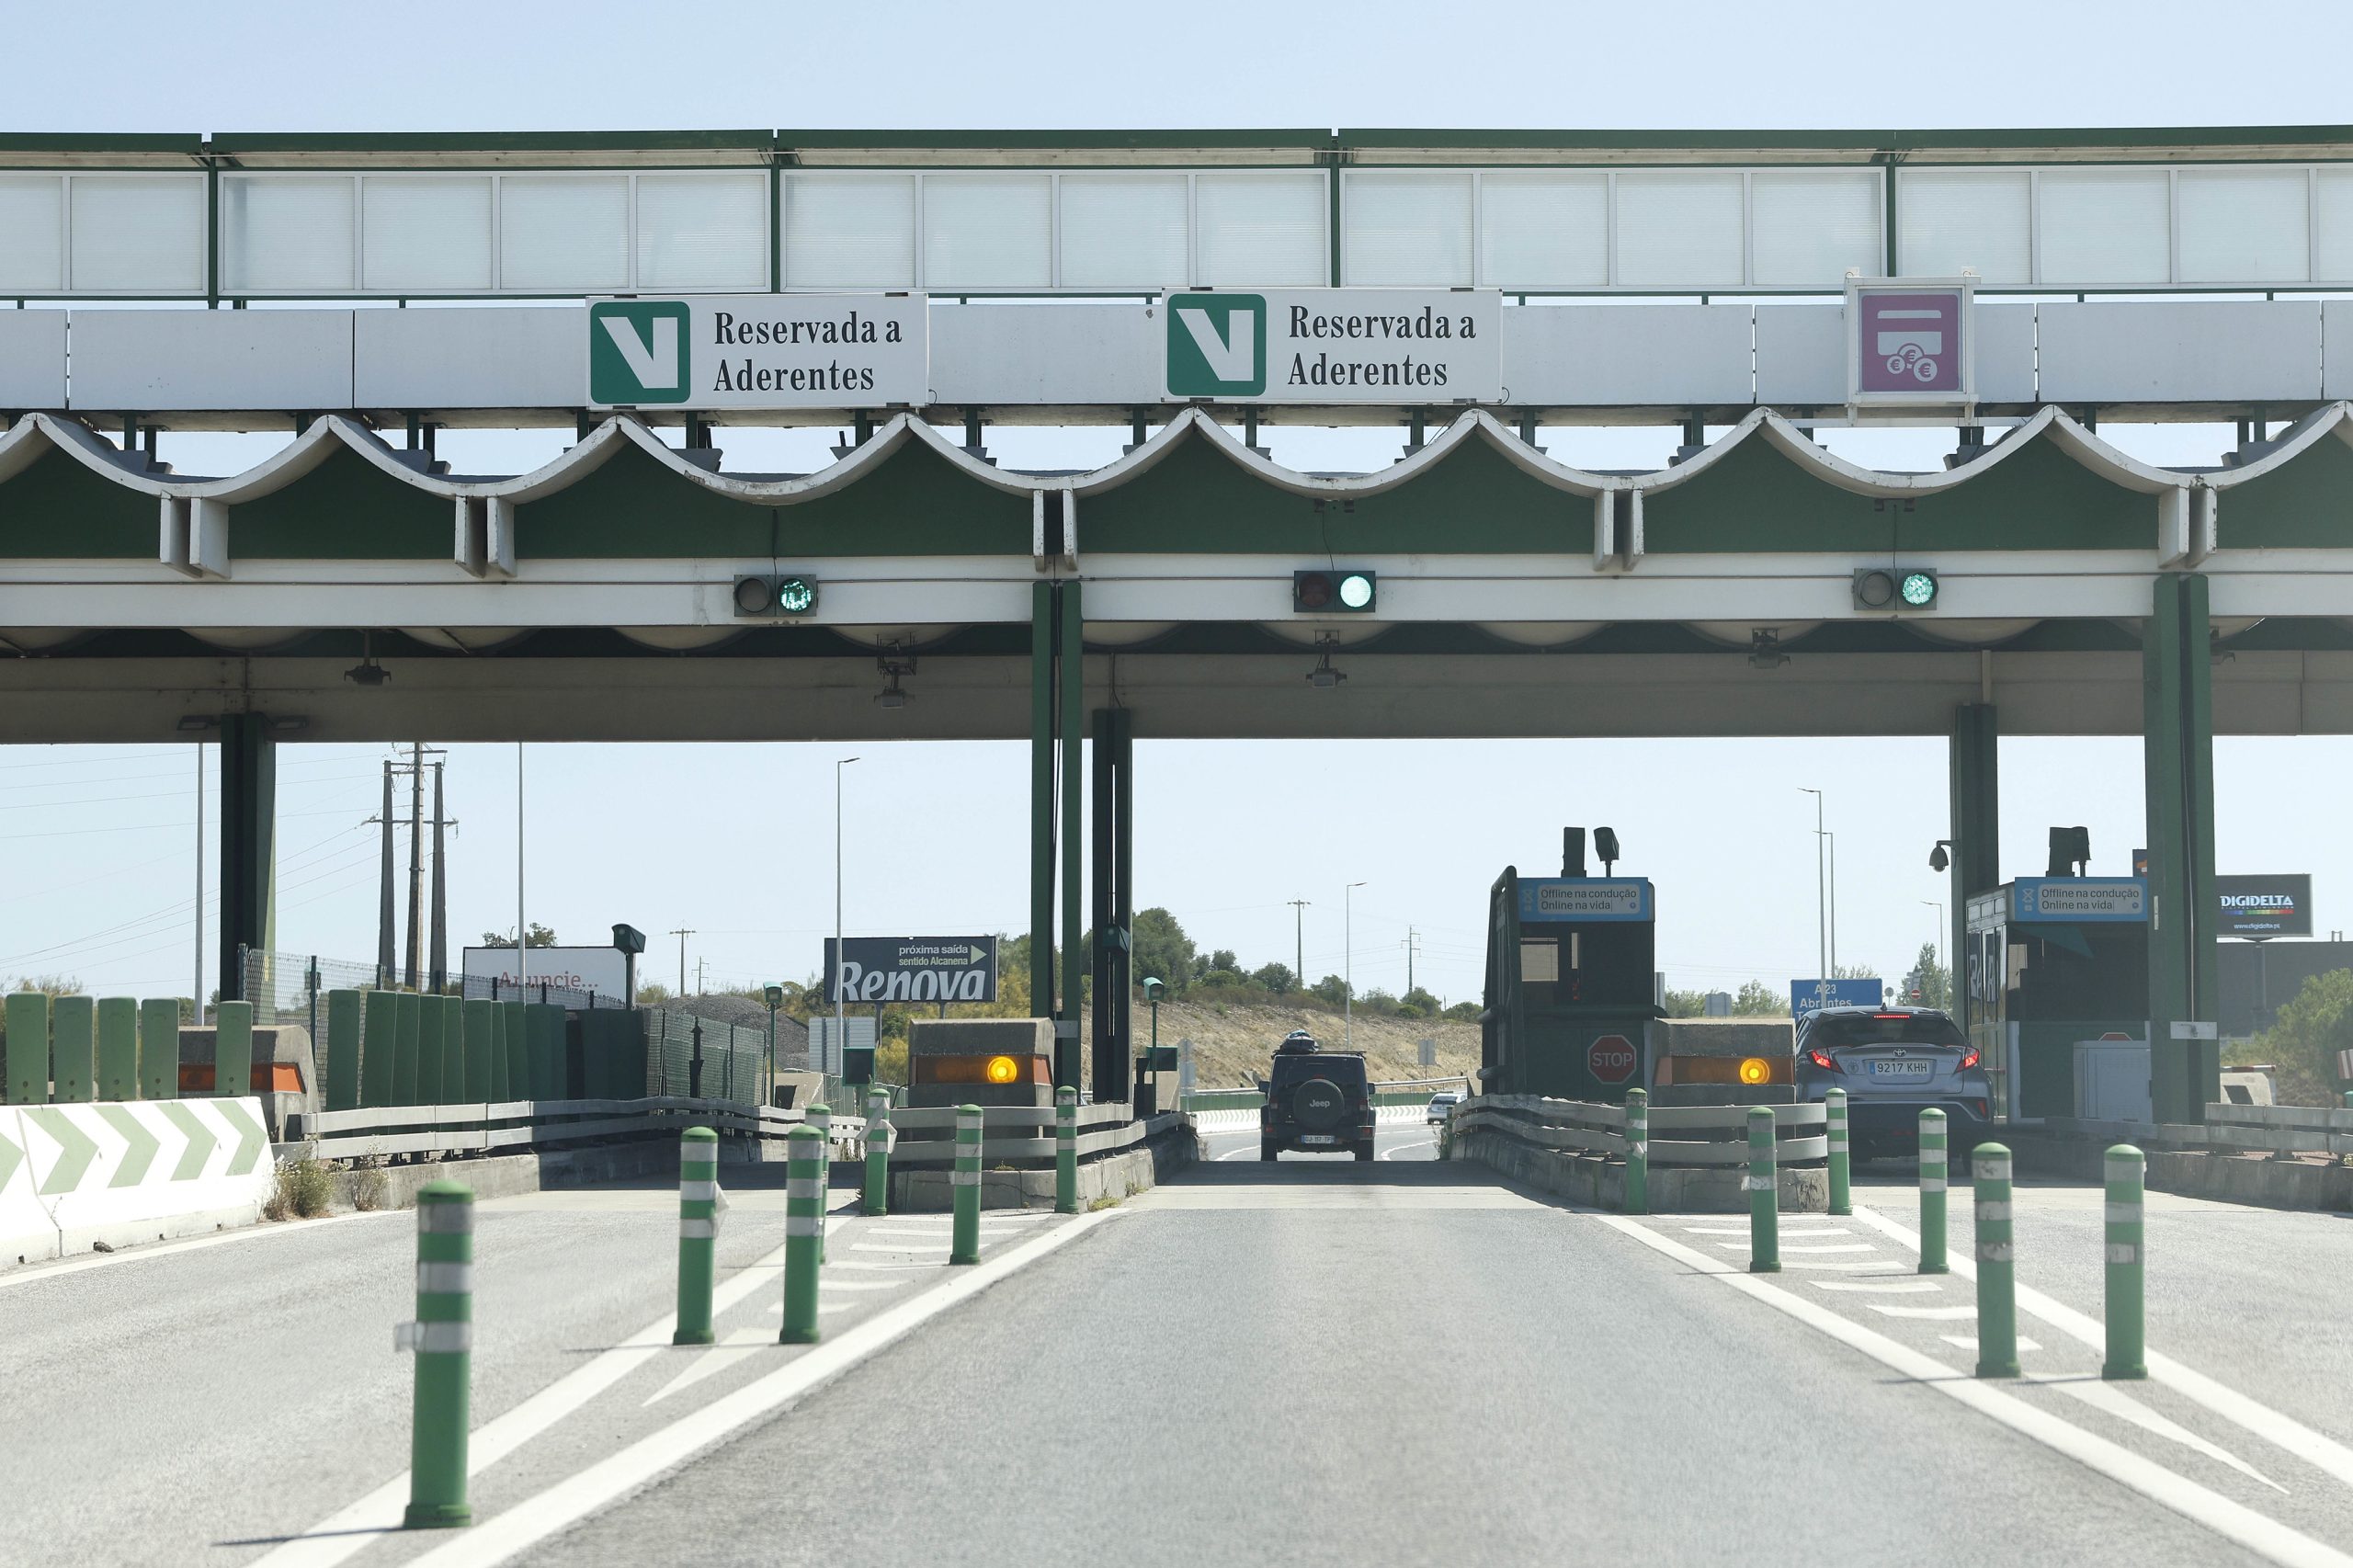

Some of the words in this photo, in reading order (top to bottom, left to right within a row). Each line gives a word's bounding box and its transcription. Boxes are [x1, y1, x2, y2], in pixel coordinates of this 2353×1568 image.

[1289, 305, 1451, 339] Reservada
[1460, 316, 1476, 339] a
[714, 311, 878, 345] Reservada
[885, 320, 903, 343] a
[1288, 352, 1448, 386] Aderentes
[713, 358, 874, 392] Aderentes
[1540, 889, 1573, 898] Offline
[1588, 889, 1637, 901] condução
[2041, 889, 2074, 898] Offline
[2076, 890, 2088, 898] na
[2090, 889, 2140, 900] condução
[2220, 894, 2294, 906] DIGIDELTA
[1540, 901, 1573, 910] Online
[1574, 902, 1587, 910] na
[1589, 901, 1610, 910] vida
[2041, 901, 2075, 910] Online
[2076, 902, 2089, 910] na
[2092, 901, 2112, 910] vida
[899, 946, 939, 956] próxima
[941, 945, 968, 954] saída
[898, 957, 928, 966] sentido
[930, 957, 968, 966] Alcanena
[833, 961, 986, 1001] Renova
[1800, 997, 1852, 1008] Abrntes
[1592, 1052, 1632, 1067] STOP
[1877, 1062, 1904, 1073] 9217
[1907, 1062, 1927, 1073] KHH
[1309, 1099, 1331, 1108] Jeep
